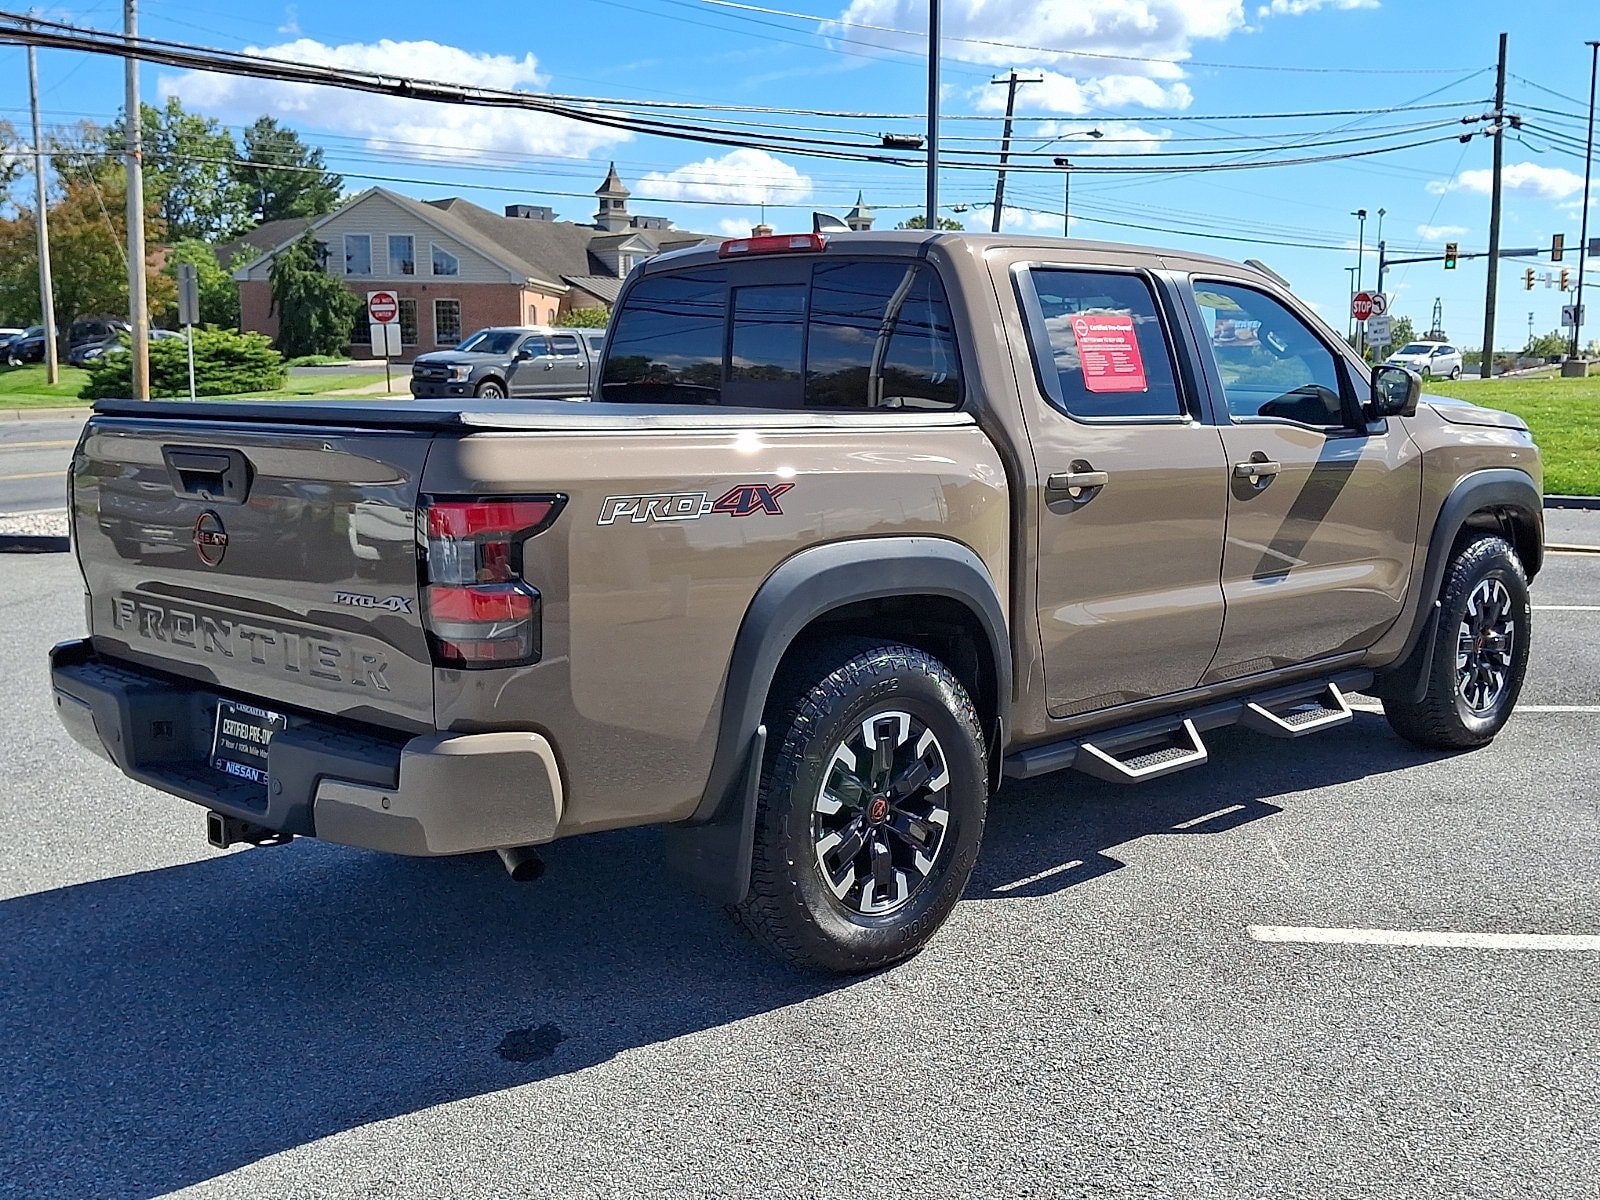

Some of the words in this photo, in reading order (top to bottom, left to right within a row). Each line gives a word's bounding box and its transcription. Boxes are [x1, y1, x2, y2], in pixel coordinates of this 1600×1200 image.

[1353, 301, 1371, 313] STOP
[333, 591, 413, 614] PRO-4X
[111, 597, 391, 691] FRONTIER
[222, 718, 248, 740] CERTIFIED
[225, 761, 258, 781] NISSAN
